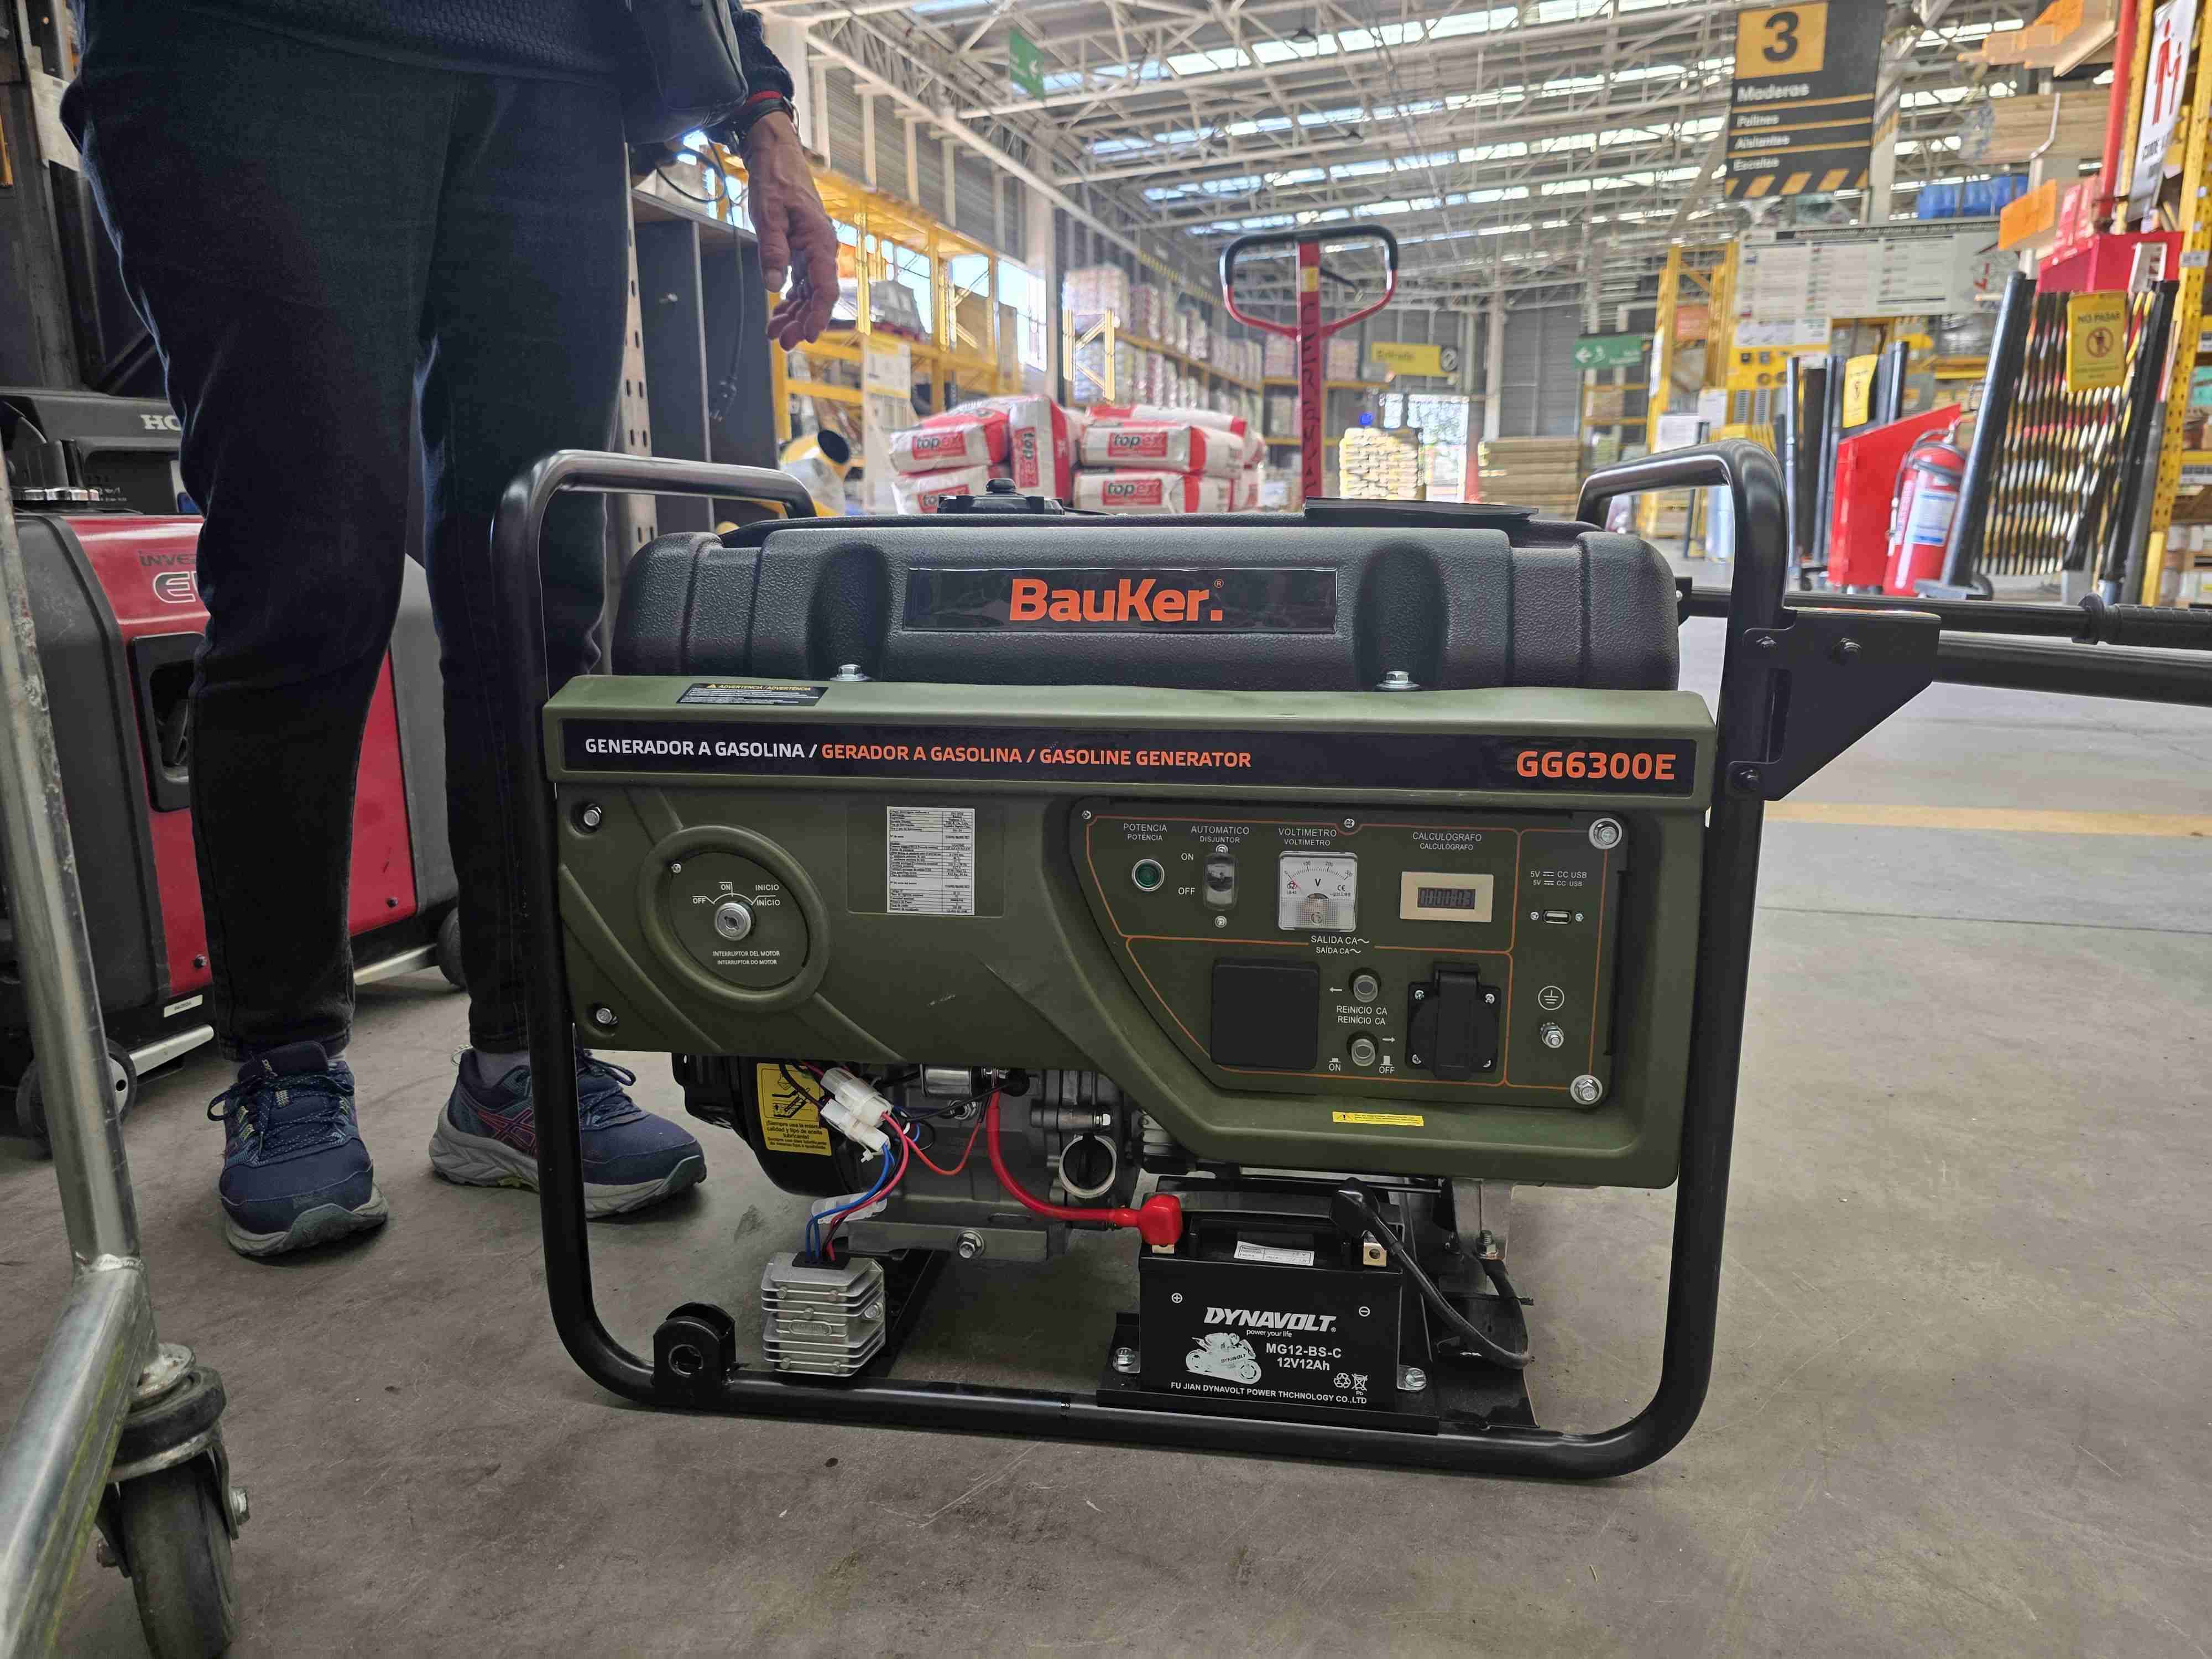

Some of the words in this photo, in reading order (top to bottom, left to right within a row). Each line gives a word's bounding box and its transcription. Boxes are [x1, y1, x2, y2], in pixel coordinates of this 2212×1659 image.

[1762, 11, 1799, 61] 3
[1113, 433, 1166, 448] topex
[1108, 481, 1159, 497] topex
[585, 738, 694, 756] GENERADOR
[698, 742, 711, 756] A
[715, 741, 805, 758] GASOLINA
[822, 744, 909, 760] GERADOR
[914, 747, 927, 761] A
[931, 747, 1022, 763] GASOLINA
[1040, 749, 1131, 765] GASOLINE
[1136, 750, 1252, 768] GENERATOR
[1517, 751, 1676, 780] GG6300E
[1123, 823, 1167, 832] POTENCIA
[1314, 878, 1322, 886] V
[1178, 887, 1196, 895] OFF
[757, 898, 781, 906] INÍCIO
[1311, 935, 1344, 944] SALIDA
[1336, 1005, 1373, 1014] REINICIO
[1376, 1007, 1387, 1015] CA
[1338, 1015, 1371, 1025] REINÍCIO
[1328, 1063, 1341, 1071] ON
[1204, 1307, 1337, 1332] DYNAVOLT
[1265, 1343, 1342, 1358] MG12-BS-C
[1277, 1357, 1330, 1371] 12V12Ah
[1203, 1385, 1245, 1395] DYNAVOLT
[1246, 1389, 1276, 1397] POWER
[1278, 1391, 1334, 1402] THCHNOLOGY
